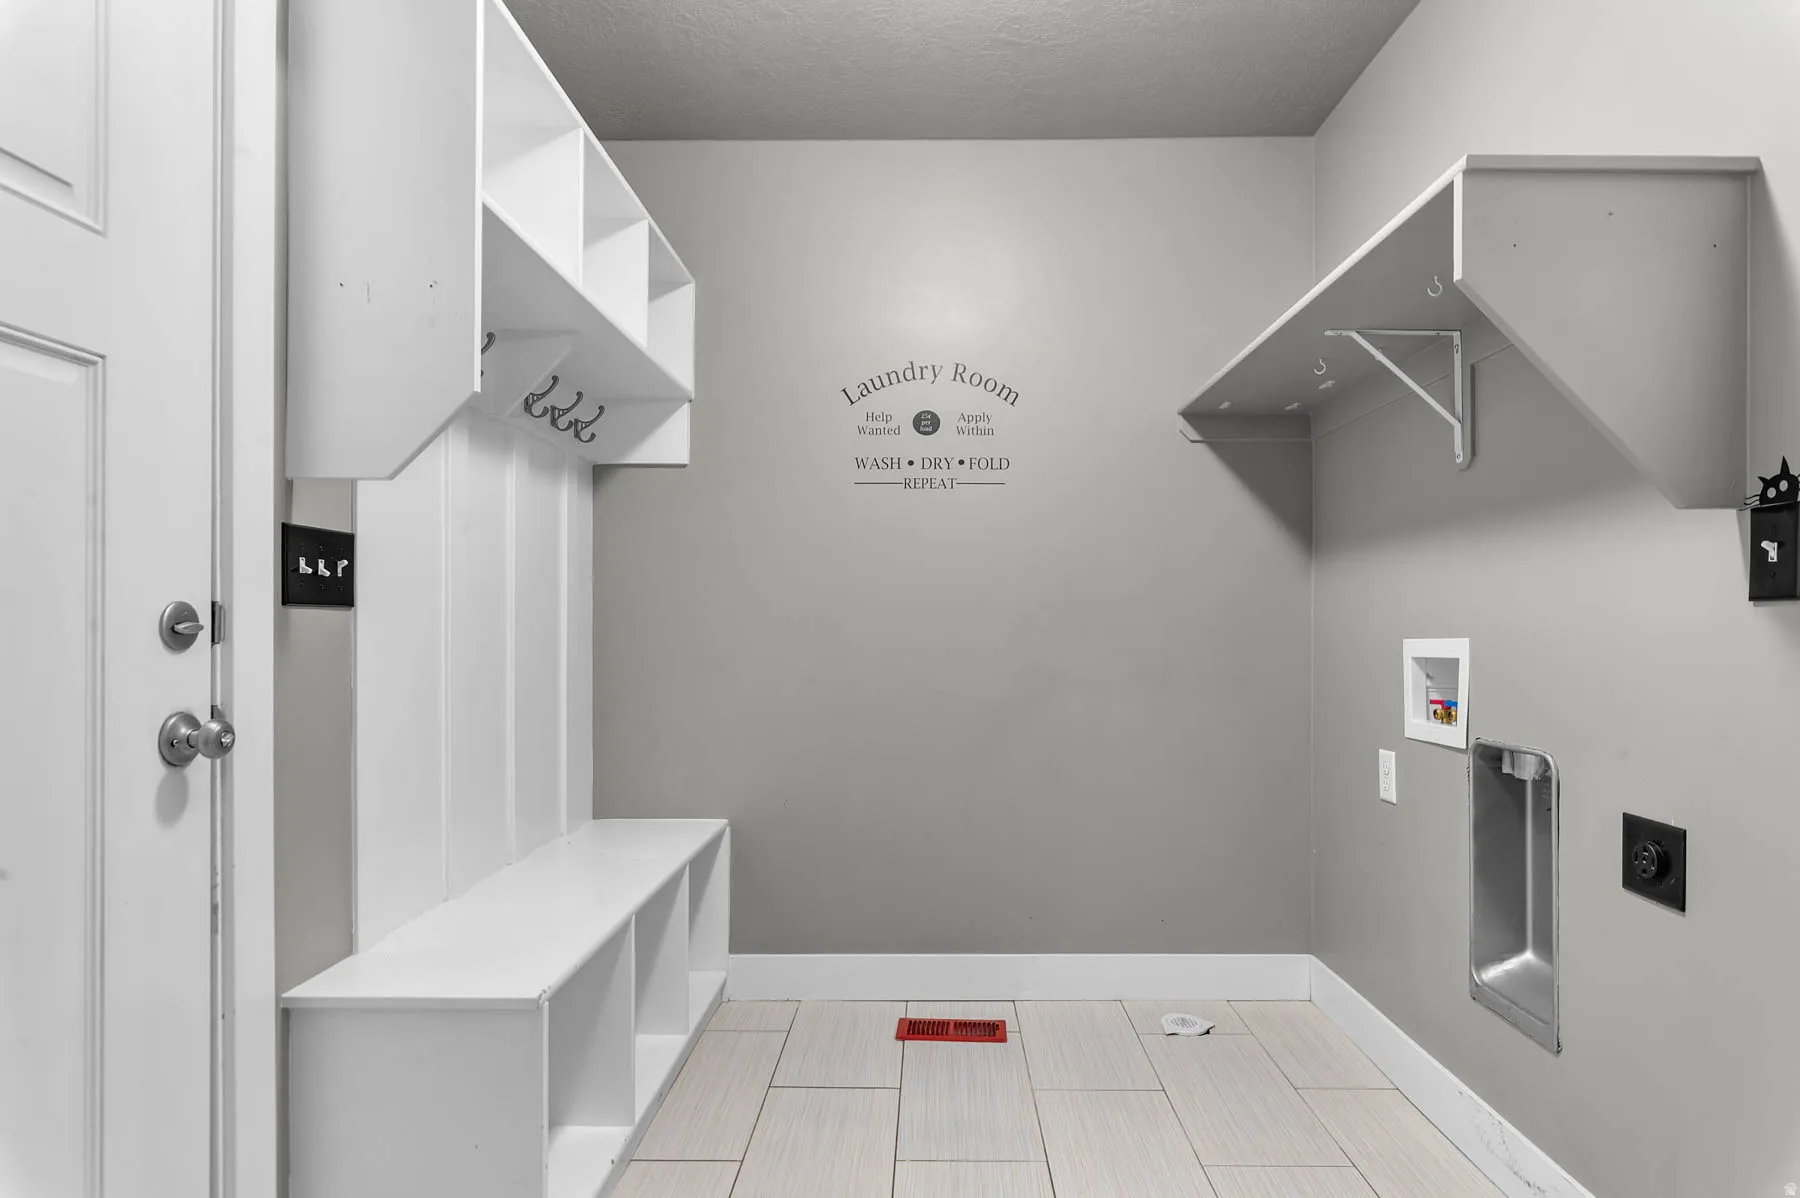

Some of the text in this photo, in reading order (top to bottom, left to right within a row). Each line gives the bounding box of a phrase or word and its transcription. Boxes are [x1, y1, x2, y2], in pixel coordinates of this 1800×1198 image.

[840, 360, 1020, 408] Laundry Room
[865, 411, 893, 425] Help
[957, 411, 993, 425] Apply
[857, 425, 901, 436] Wanted
[956, 425, 995, 436] Within
[854, 456, 1010, 471] WASH DRY FOLD
[903, 477, 957, 490] REPEAT
